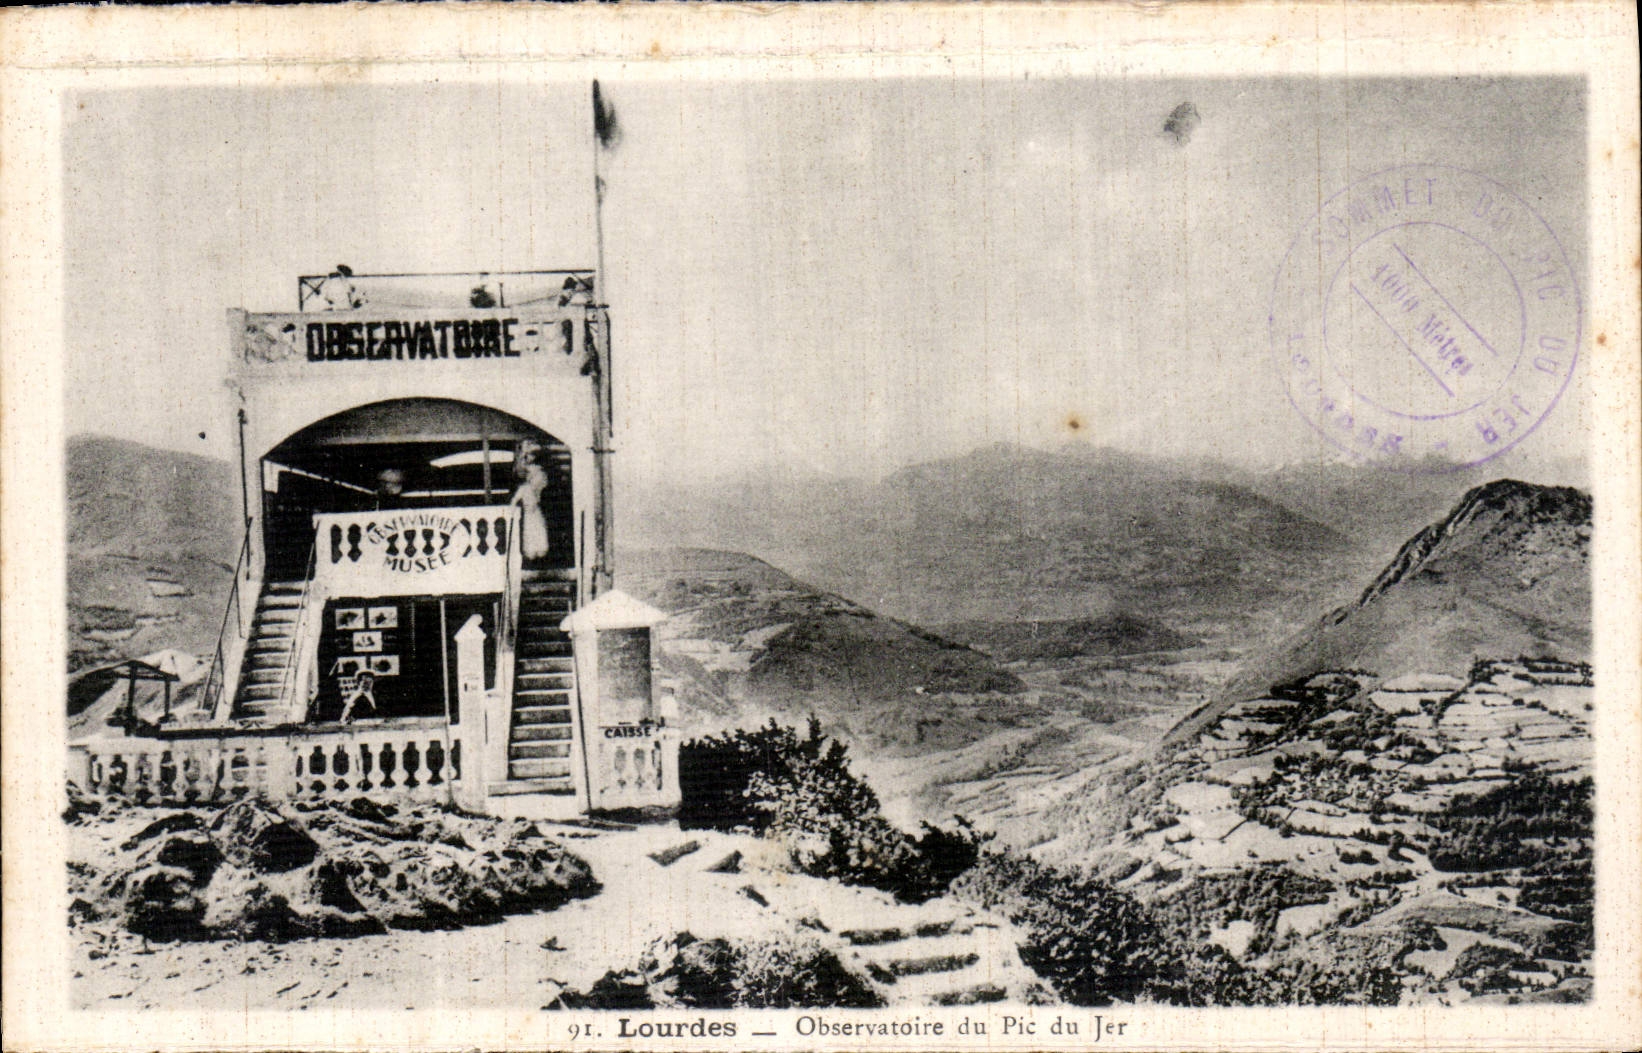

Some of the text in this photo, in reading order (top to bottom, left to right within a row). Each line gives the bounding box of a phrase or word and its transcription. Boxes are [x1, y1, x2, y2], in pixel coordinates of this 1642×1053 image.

[1313, 177, 1438, 256] SOMMET
[1475, 393, 1531, 444] JER
[1370, 262, 1420, 313] 1000
[306, 318, 520, 362] OBSERVATOIRE
[604, 726, 651, 739] CAISSE
